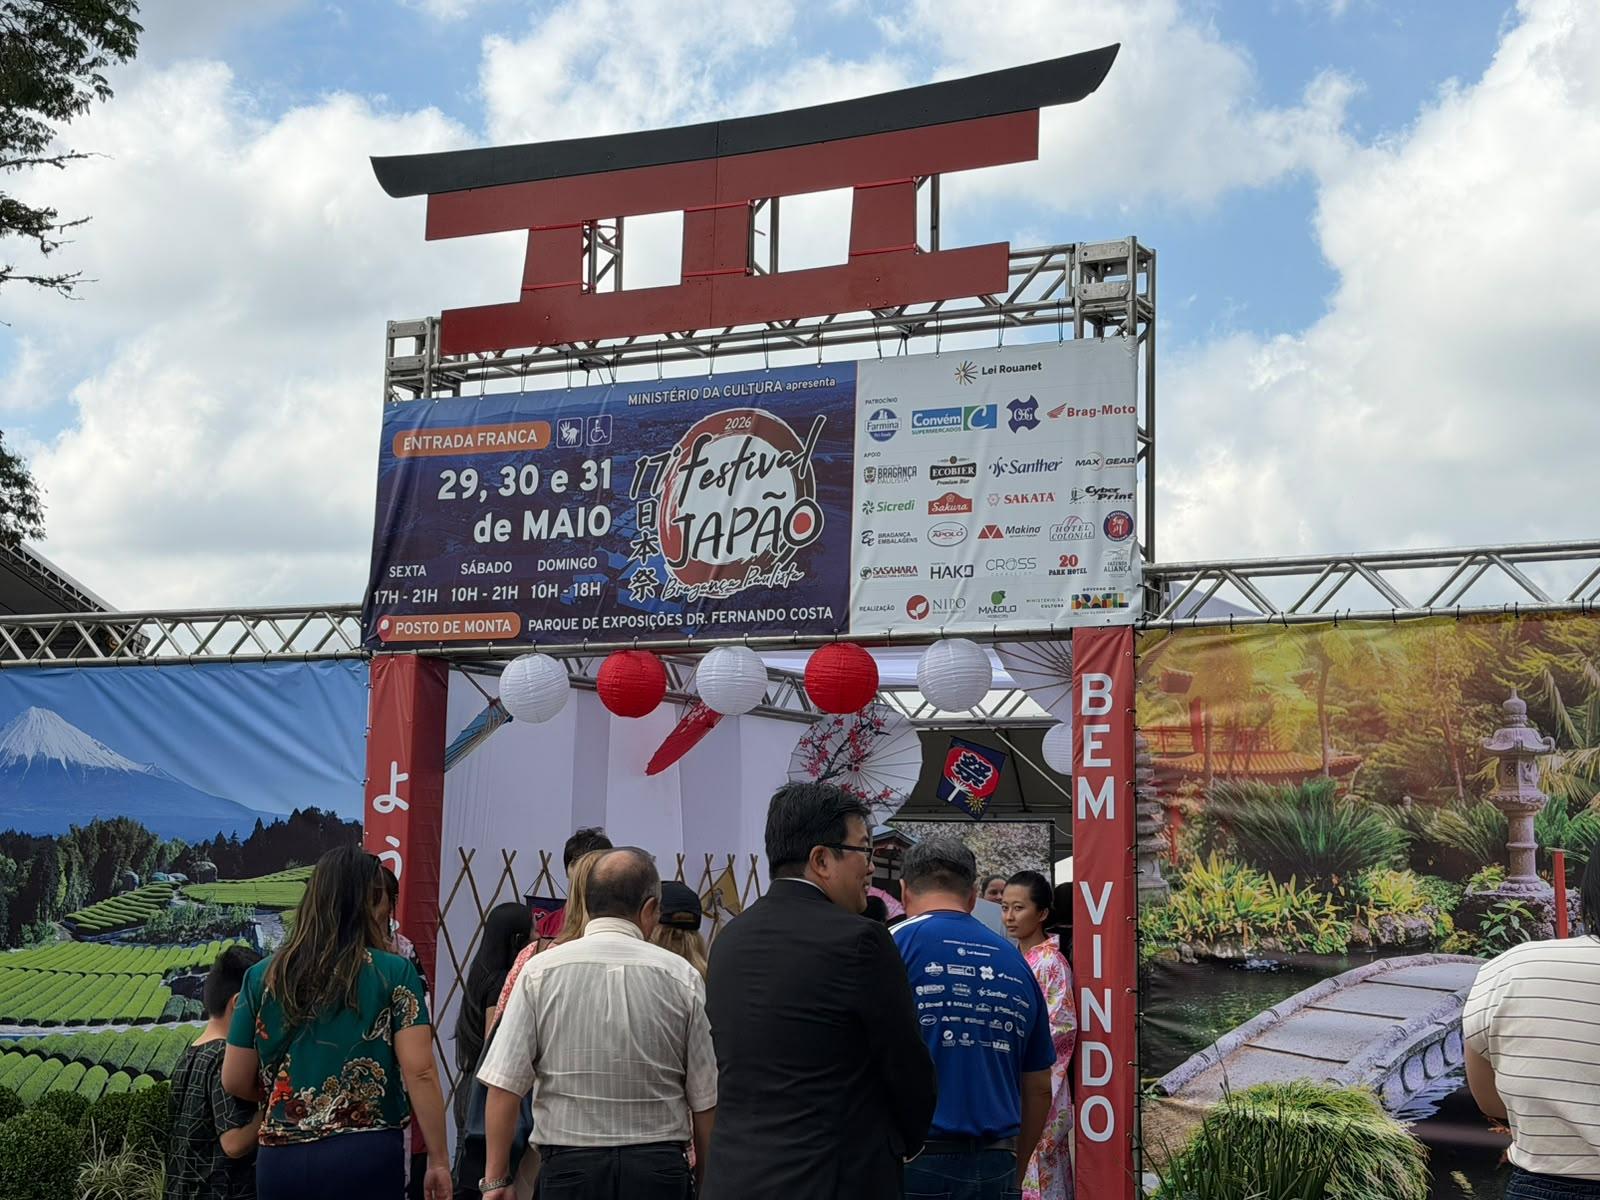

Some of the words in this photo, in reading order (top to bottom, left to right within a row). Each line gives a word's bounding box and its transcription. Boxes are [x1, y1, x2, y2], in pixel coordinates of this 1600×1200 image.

[982, 366, 997, 375] Lei
[999, 362, 1042, 374] Rouanet
[628, 386, 699, 405] MINISTÉRIO
[703, 385, 720, 398] DA
[724, 380, 782, 397] CULTURA
[785, 377, 836, 391] apresenta
[865, 396, 898, 405] PATROCÍNIO
[1067, 404, 1136, 418] Brag-Moto
[724, 417, 752, 430] 2026
[867, 420, 899, 431] Farmina
[913, 413, 961, 427] Convém
[404, 434, 473, 450] ENTRADA
[477, 429, 537, 447] FRANCA
[1008, 458, 1062, 475] Santher
[1075, 459, 1100, 467] MAX
[1105, 457, 1135, 465] GEAR
[878, 466, 917, 480] BRAGANÇA
[932, 465, 975, 477] ECOBIER
[438, 468, 487, 502] 29,
[498, 464, 539, 496] 30
[551, 470, 568, 493] e
[579, 458, 612, 491] 31
[1004, 492, 1055, 504] SAKATA
[1085, 485, 1120, 497] Cyber
[876, 499, 915, 512] Sicredi
[931, 502, 969, 512] Sakura
[473, 512, 512, 543] de
[523, 505, 612, 541] MAIO
[667, 491, 823, 568] JAPÃO
[1006, 524, 1041, 534] Makino
[1055, 524, 1090, 533] HOTEL
[878, 531, 911, 539] BRAGANÇA
[1051, 531, 1093, 540] COLONIAL
[627, 498, 660, 602] 日本祭
[460, 560, 513, 575] SÁBADO
[537, 557, 598, 572] DOMINGO
[985, 557, 1038, 571] CROSS
[1059, 554, 1079, 567] 20
[389, 565, 427, 577] SEXTA
[873, 565, 918, 574] SASAHARA
[1103, 565, 1132, 573] ALIANÇA
[660, 576, 741, 602] Bragança
[743, 562, 805, 588] Paulista
[374, 590, 399, 604] 17H
[412, 589, 438, 603] 21H
[451, 587, 478, 601] 10H
[492, 586, 519, 600] 21H
[531, 584, 559, 598] 10H
[573, 582, 601, 596] 18H
[932, 598, 966, 610] NIPO
[1071, 592, 1129, 609] BRASIL
[528, 618, 579, 631] PARQUE
[583, 617, 599, 630] DE
[602, 611, 682, 630] EXPOSIÇÕES
[687, 612, 708, 626] DR.
[712, 609, 786, 624] FERNANDO
[790, 606, 833, 620] COSTA
[395, 621, 439, 635] POSTO
[443, 621, 460, 633] DE
[464, 619, 512, 633] MONTA
[1077, 672, 1115, 820] BEM
[1079, 881, 1115, 1142] VINDO
